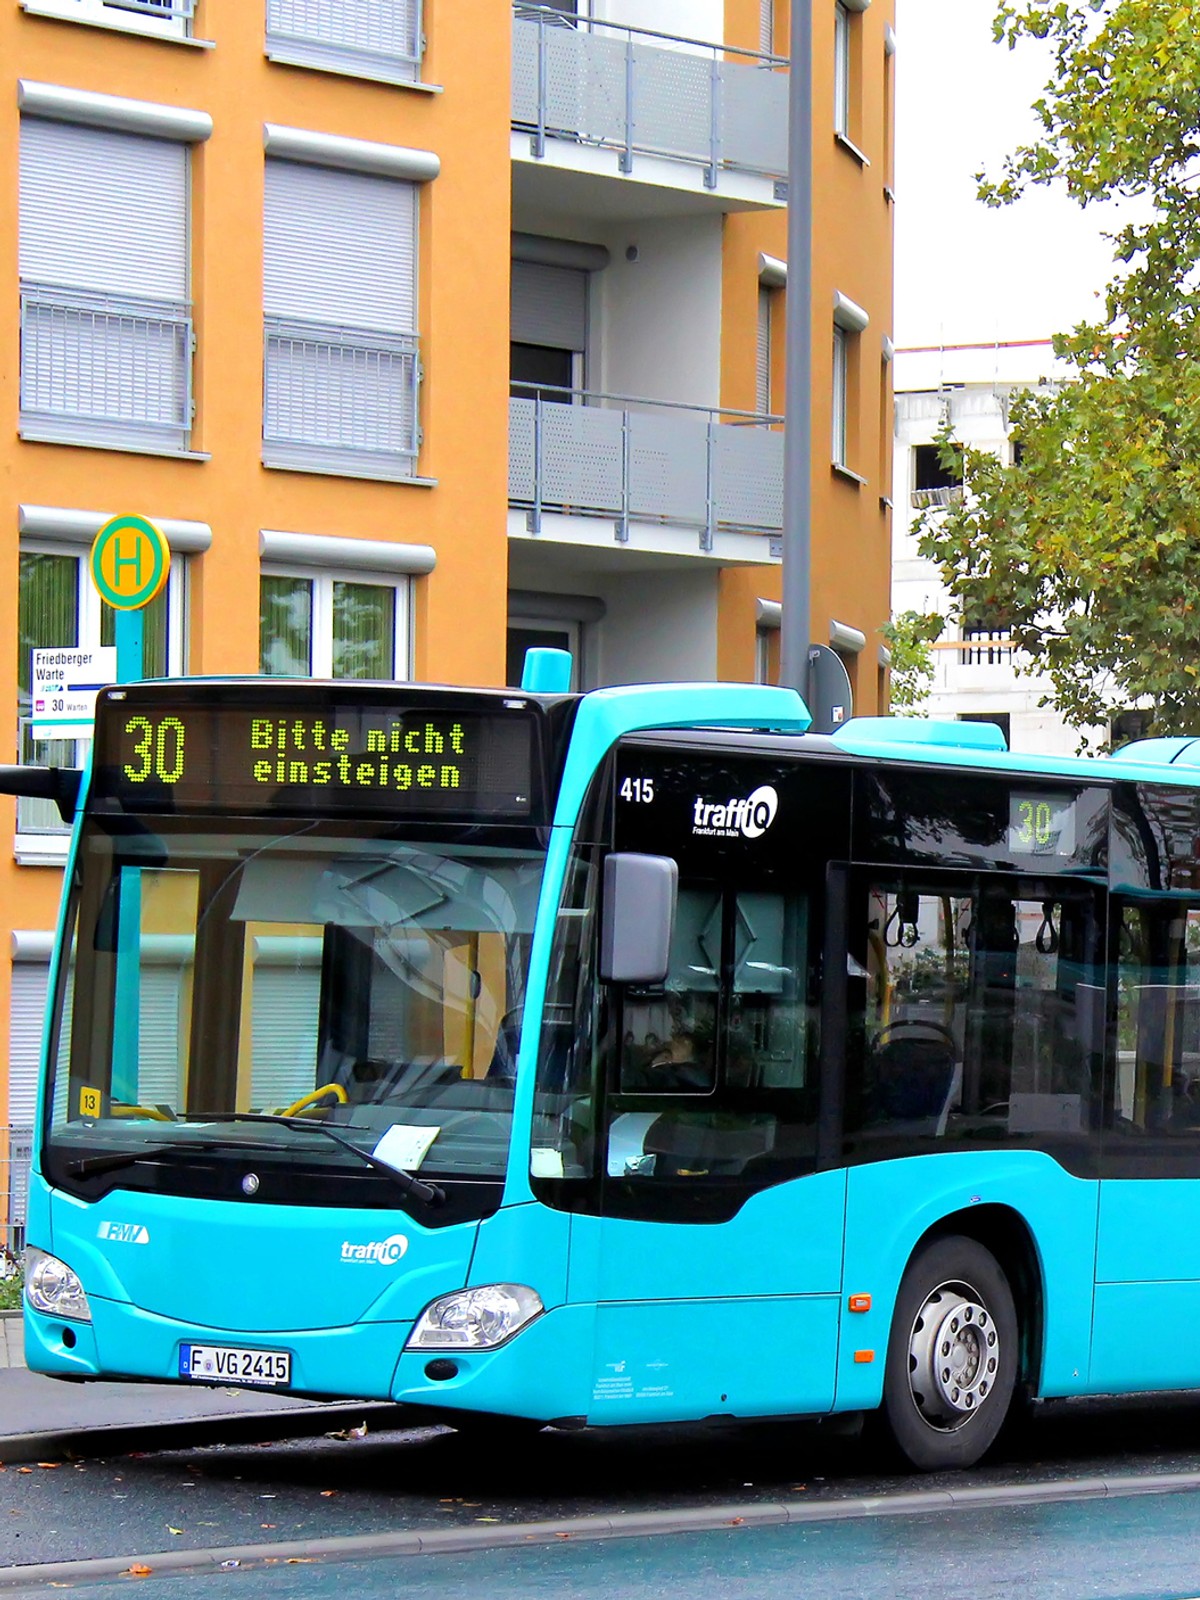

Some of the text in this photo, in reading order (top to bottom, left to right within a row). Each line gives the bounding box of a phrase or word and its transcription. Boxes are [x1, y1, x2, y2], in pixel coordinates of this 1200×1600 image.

[115, 536, 140, 586] H
[36, 653, 93, 667] Friedberger
[36, 668, 65, 681] Warte
[52, 699, 64, 711] 30
[124, 716, 185, 783] 30
[251, 719, 464, 754] Bitte nicht
[253, 752, 460, 790] einsteigen
[620, 777, 654, 804] 415
[693, 785, 778, 838] traffiQ
[1018, 801, 1051, 844] 30
[84, 1095, 96, 1110] 13
[341, 1234, 409, 1266] traffiQ
[192, 1350, 203, 1371] F
